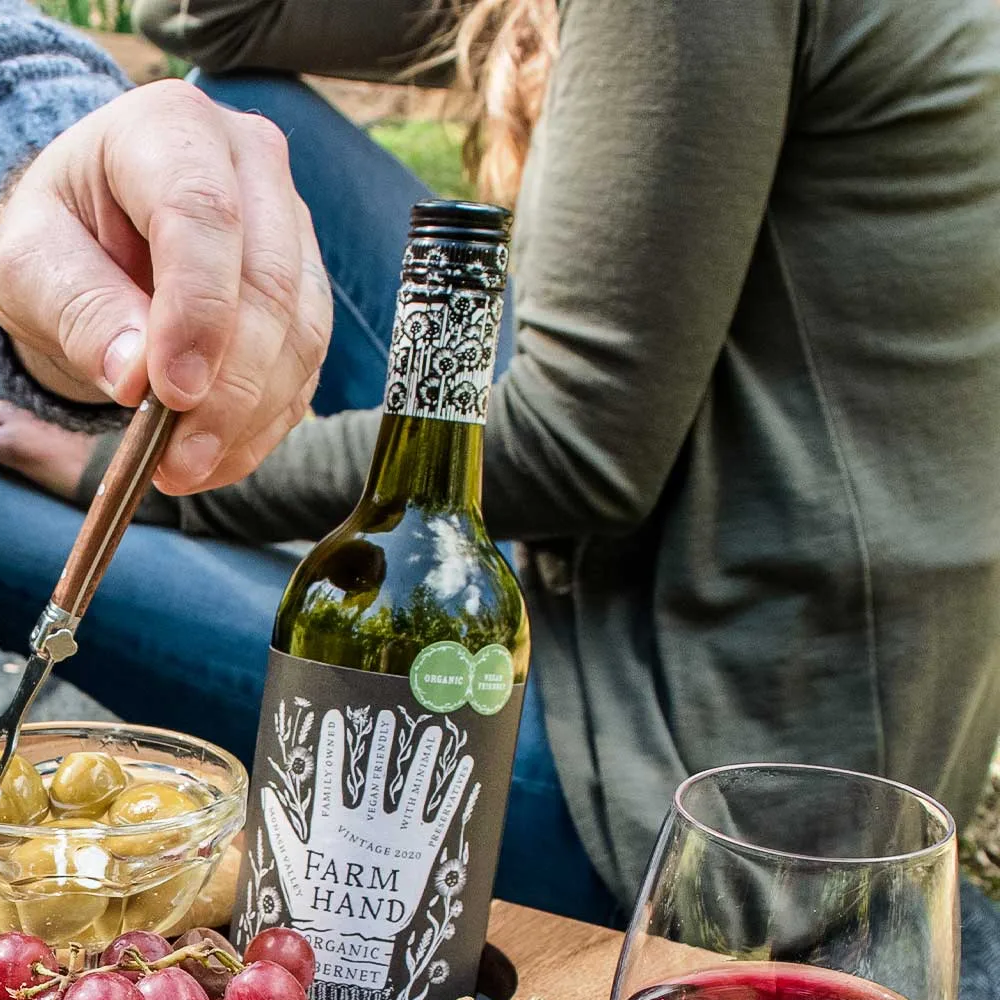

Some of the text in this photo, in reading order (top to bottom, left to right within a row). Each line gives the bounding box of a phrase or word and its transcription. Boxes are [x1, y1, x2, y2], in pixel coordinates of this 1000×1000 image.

[423, 673, 464, 686] ORGANIC
[321, 721, 336, 817] FAMILY OWNED
[367, 720, 390, 821] VEGAN FRIENDLY
[399, 736, 436, 831] WITH MINIMAL
[428, 764, 470, 848] PRESERVATIVES
[338, 825, 422, 859] VINTAGE 2020
[283, 855, 303, 896] VALLEY
[304, 849, 400, 892] FARM
[310, 886, 405, 923] HAND
[314, 961, 381, 983] BERNET
